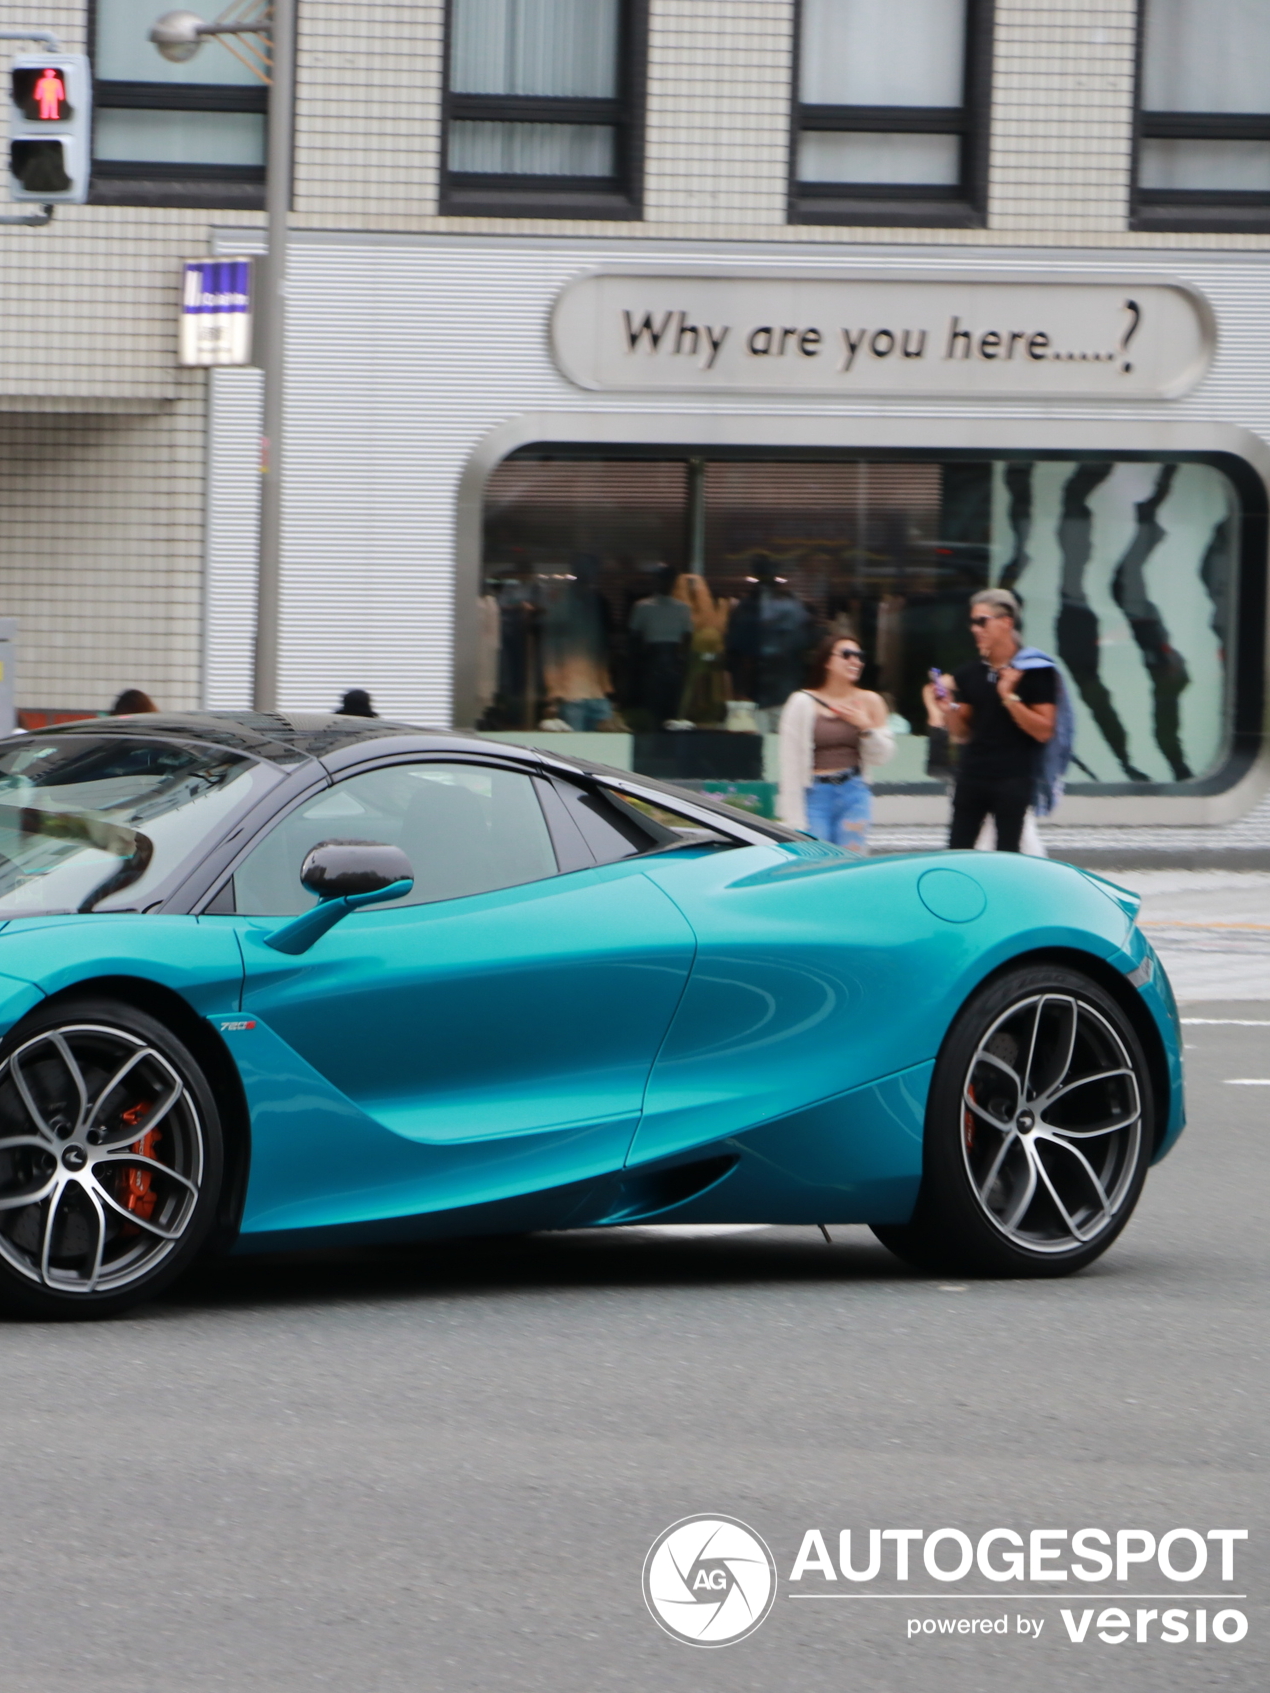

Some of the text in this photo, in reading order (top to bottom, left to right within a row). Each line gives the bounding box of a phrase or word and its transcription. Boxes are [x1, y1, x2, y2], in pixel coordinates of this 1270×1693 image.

[622, 309, 729, 370] Why
[746, 325, 822, 357] are
[839, 326, 925, 372] you
